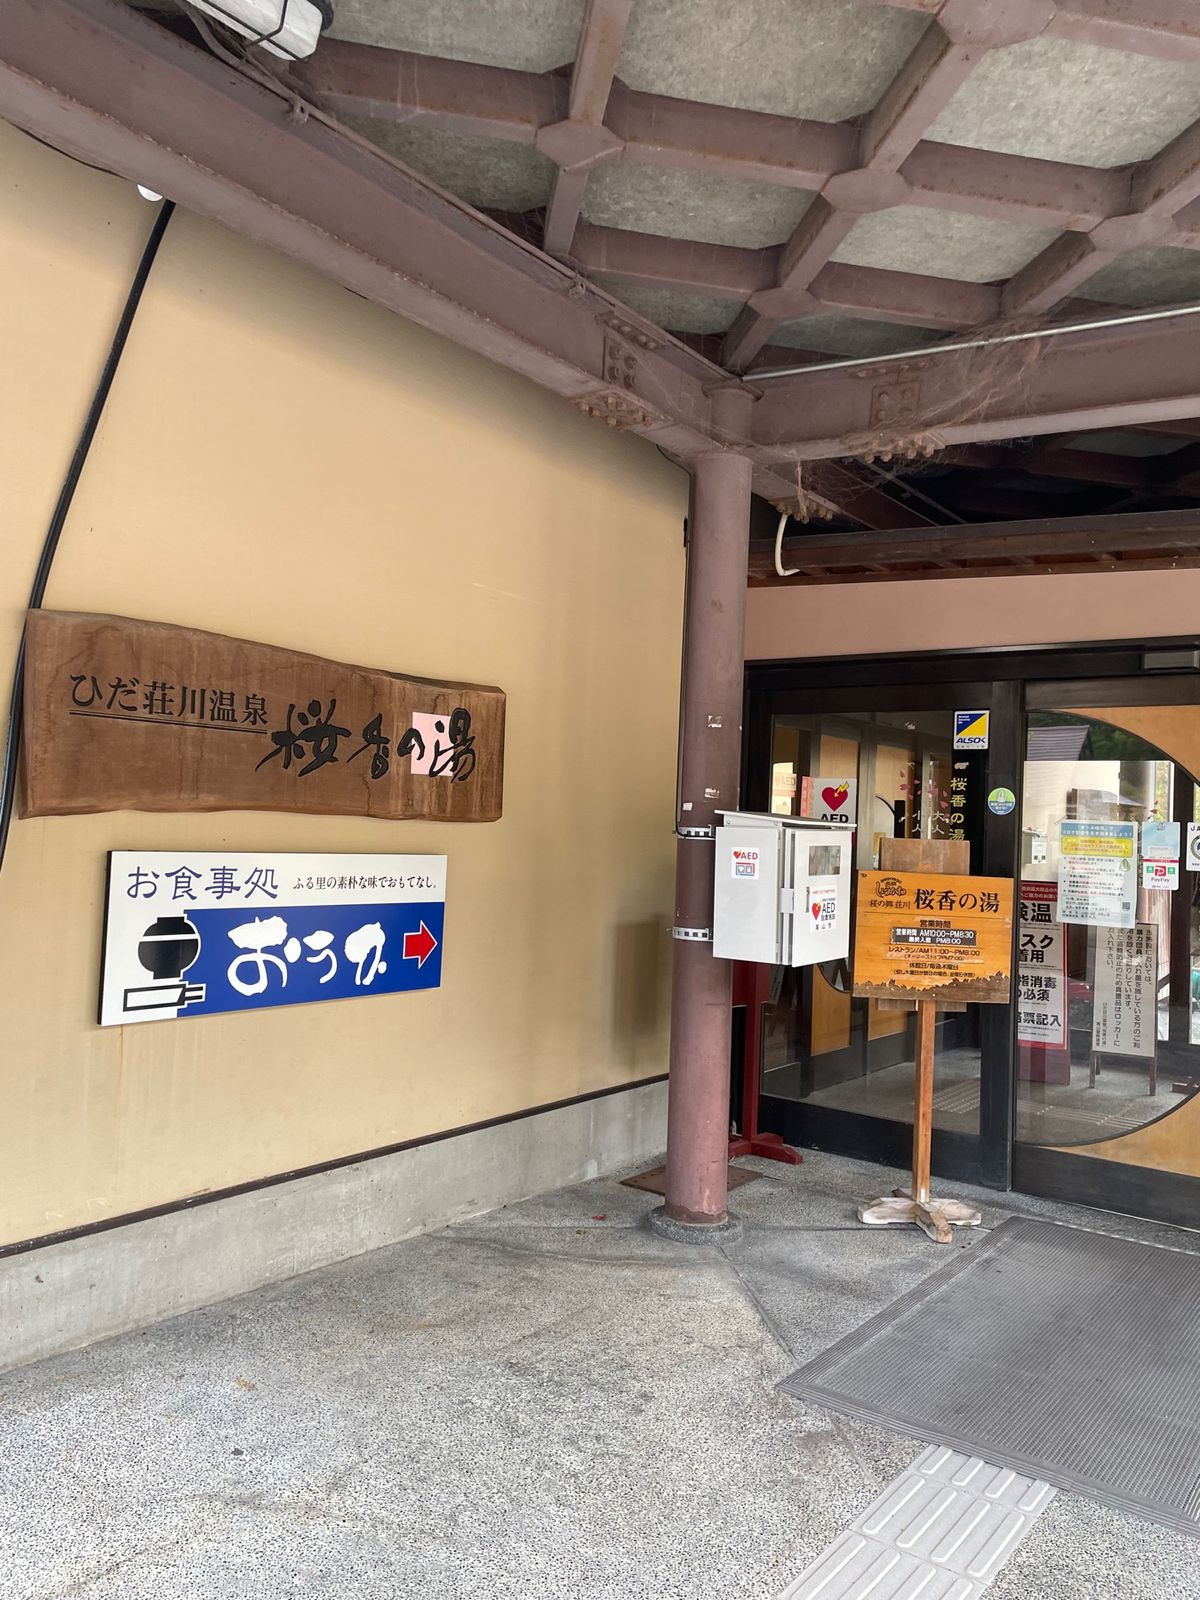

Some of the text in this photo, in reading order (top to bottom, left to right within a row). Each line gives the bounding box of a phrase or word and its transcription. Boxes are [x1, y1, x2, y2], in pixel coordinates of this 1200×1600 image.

[69, 674, 269, 726] ひだ荘川温泉
[255, 699, 477, 783] 桜香の湯
[821, 813, 849, 823] AED
[949, 777, 968, 840] 桜香の湯
[740, 851, 758, 860] AED
[126, 865, 279, 901] お食事処
[293, 876, 437, 890] ふる里の素朴な味でおもてなし。
[822, 902, 836, 914] AED
[914, 888, 1000, 913] 桜香の湯
[1018, 988, 1050, 1002] 必須
